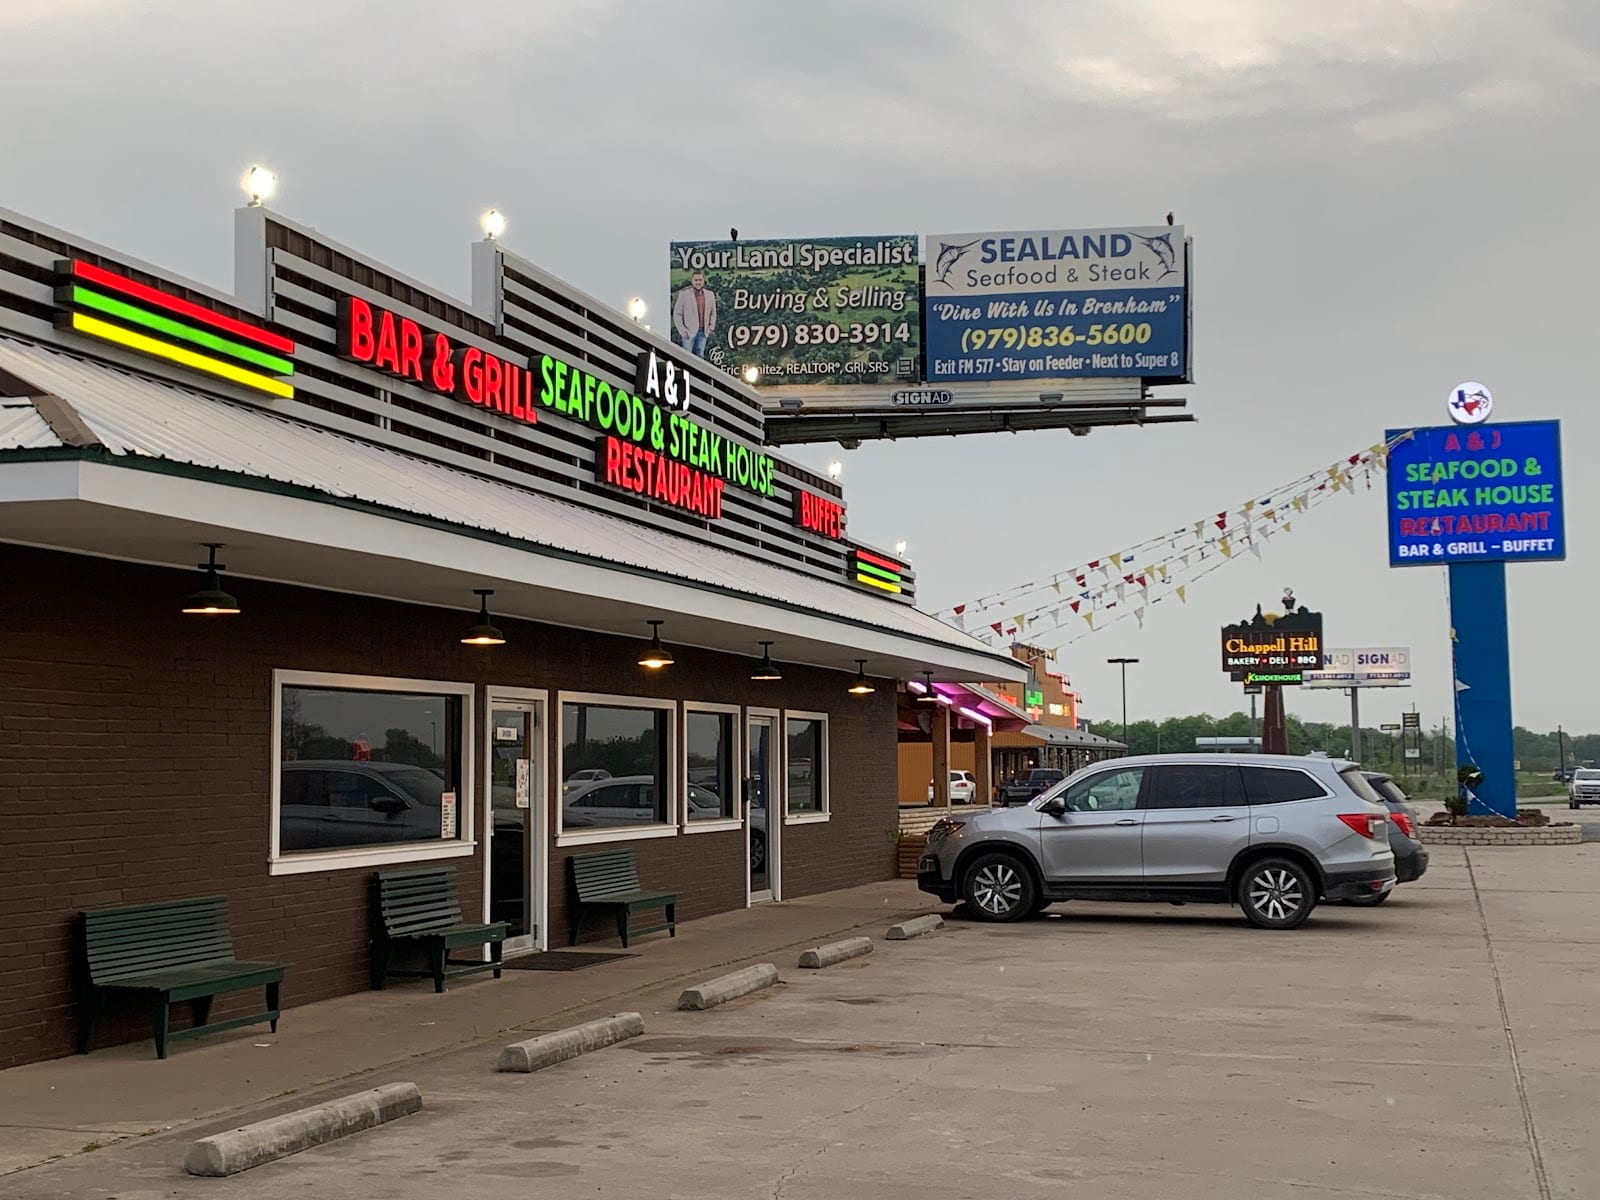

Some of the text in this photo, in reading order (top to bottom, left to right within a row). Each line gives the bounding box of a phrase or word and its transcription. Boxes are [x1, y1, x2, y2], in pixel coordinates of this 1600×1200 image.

[678, 241, 912, 271] Your Land Specialist
[981, 233, 1132, 264] SEALAND
[967, 262, 1150, 287] Seafood & Steak
[734, 286, 905, 313] Buying & Selling
[987, 300, 1029, 318] With
[1034, 299, 1054, 316] Us
[1058, 298, 1078, 316] In
[727, 322, 910, 348] (979) 830-3914
[961, 323, 1152, 353] (979)836-5600
[352, 296, 538, 425] BAR & GRILL
[741, 364, 785, 376] Bnitez,
[845, 363, 867, 374] GRI,
[869, 362, 889, 373] SRS
[935, 351, 1179, 375] Exit FM 577 Stay on Feeder Next to Super 8
[646, 351, 690, 411] A & J
[540, 354, 775, 497] SEAFOOD & STEAK HOUSE
[1445, 430, 1501, 452] A & J
[606, 435, 725, 520] RESTAURANT
[1406, 457, 1542, 482] SEAFOOD &
[1396, 484, 1554, 510] STEAK HOUSE
[801, 490, 844, 540] BUFFET
[1398, 543, 1430, 557] BAR
[1432, 543, 1444, 555] &
[1447, 541, 1487, 555] GRILL
[1502, 538, 1555, 552] BUFFET
[1226, 637, 1318, 655] Chappell Hill
[1228, 656, 1260, 666] BAKERY
[1269, 656, 1289, 665] DELI
[1297, 655, 1317, 664] BBQ
